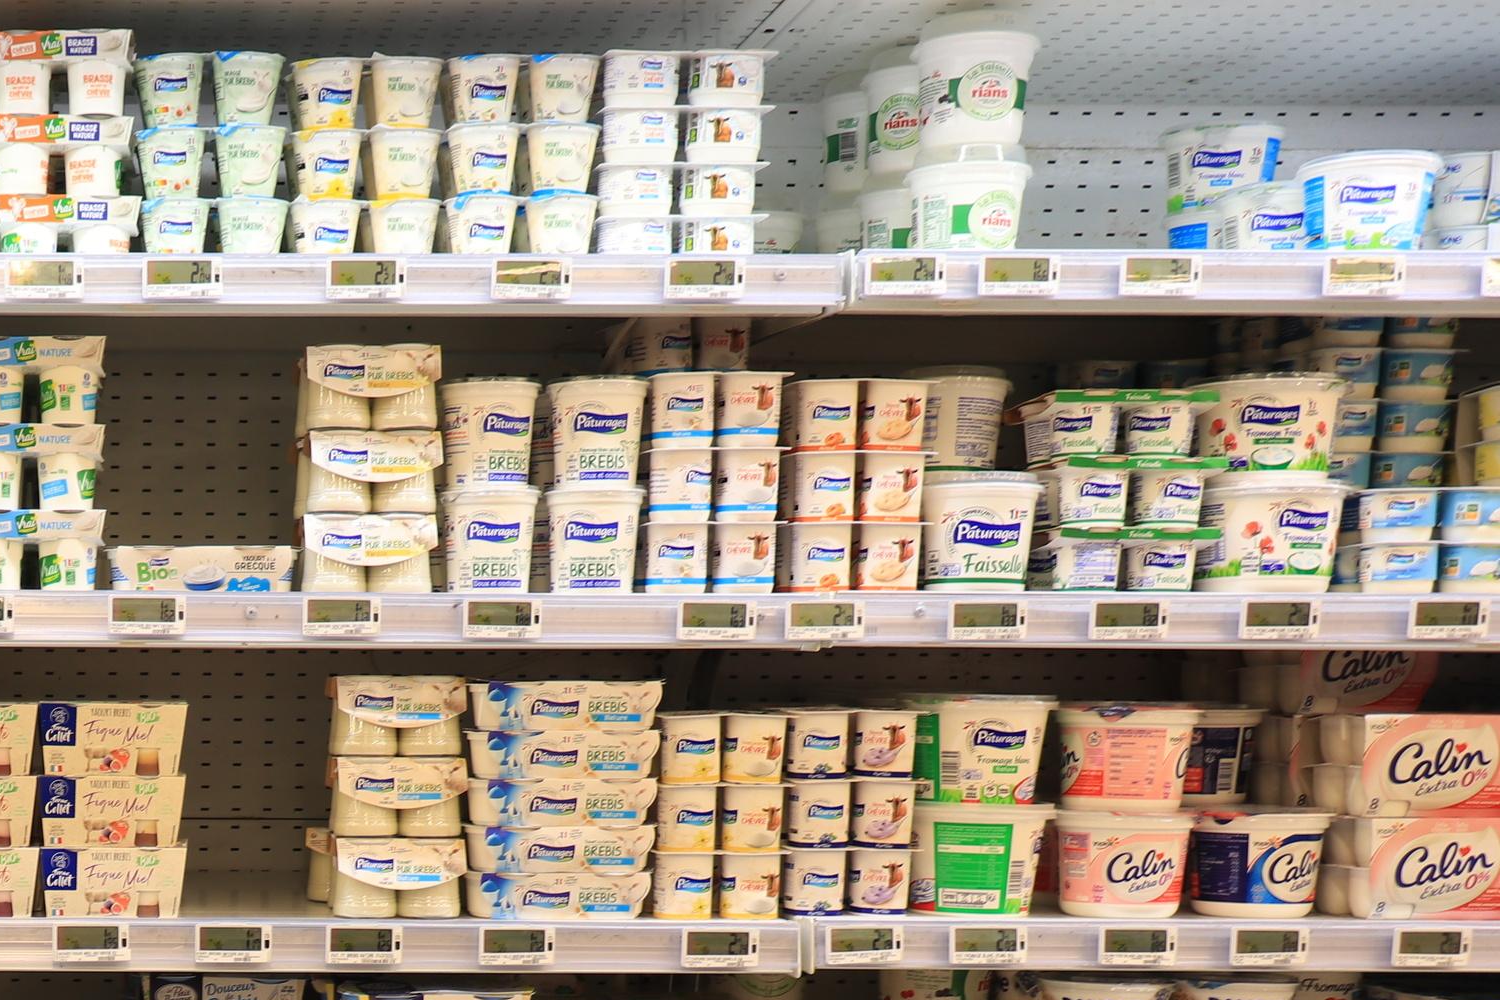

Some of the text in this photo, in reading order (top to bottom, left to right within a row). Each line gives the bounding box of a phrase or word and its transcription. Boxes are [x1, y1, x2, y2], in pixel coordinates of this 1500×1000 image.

[971, 87, 1008, 100] rians
[982, 212, 1012, 229] rians
[39, 347, 72, 358] NATURE
[39, 434, 72, 444] NATURE
[1245, 429, 1282, 438] Fromage
[489, 456, 525, 470] BREBIS
[580, 456, 626, 469] BREBIS
[40, 521, 72, 530] NATURE
[963, 553, 1022, 574] Faisselle
[473, 564, 518, 577] BREBIS
[571, 564, 616, 577] BREBIS
[413, 703, 441, 712] BREBIS
[588, 700, 627, 713] BREBIS
[587, 750, 625, 762] BREBIS
[976, 755, 1009, 768] Fromage
[1390, 738, 1491, 786] Calin
[1415, 769, 1488, 797] Extra 0%
[586, 798, 624, 810] BREBIS
[583, 845, 621, 857] BREBIS
[1107, 849, 1175, 885] Calin
[1396, 841, 1493, 888] Calin
[1128, 877, 1157, 894] Extra
[1420, 871, 1490, 902] Extra 0%
[204, 981, 254, 998] Douceur
